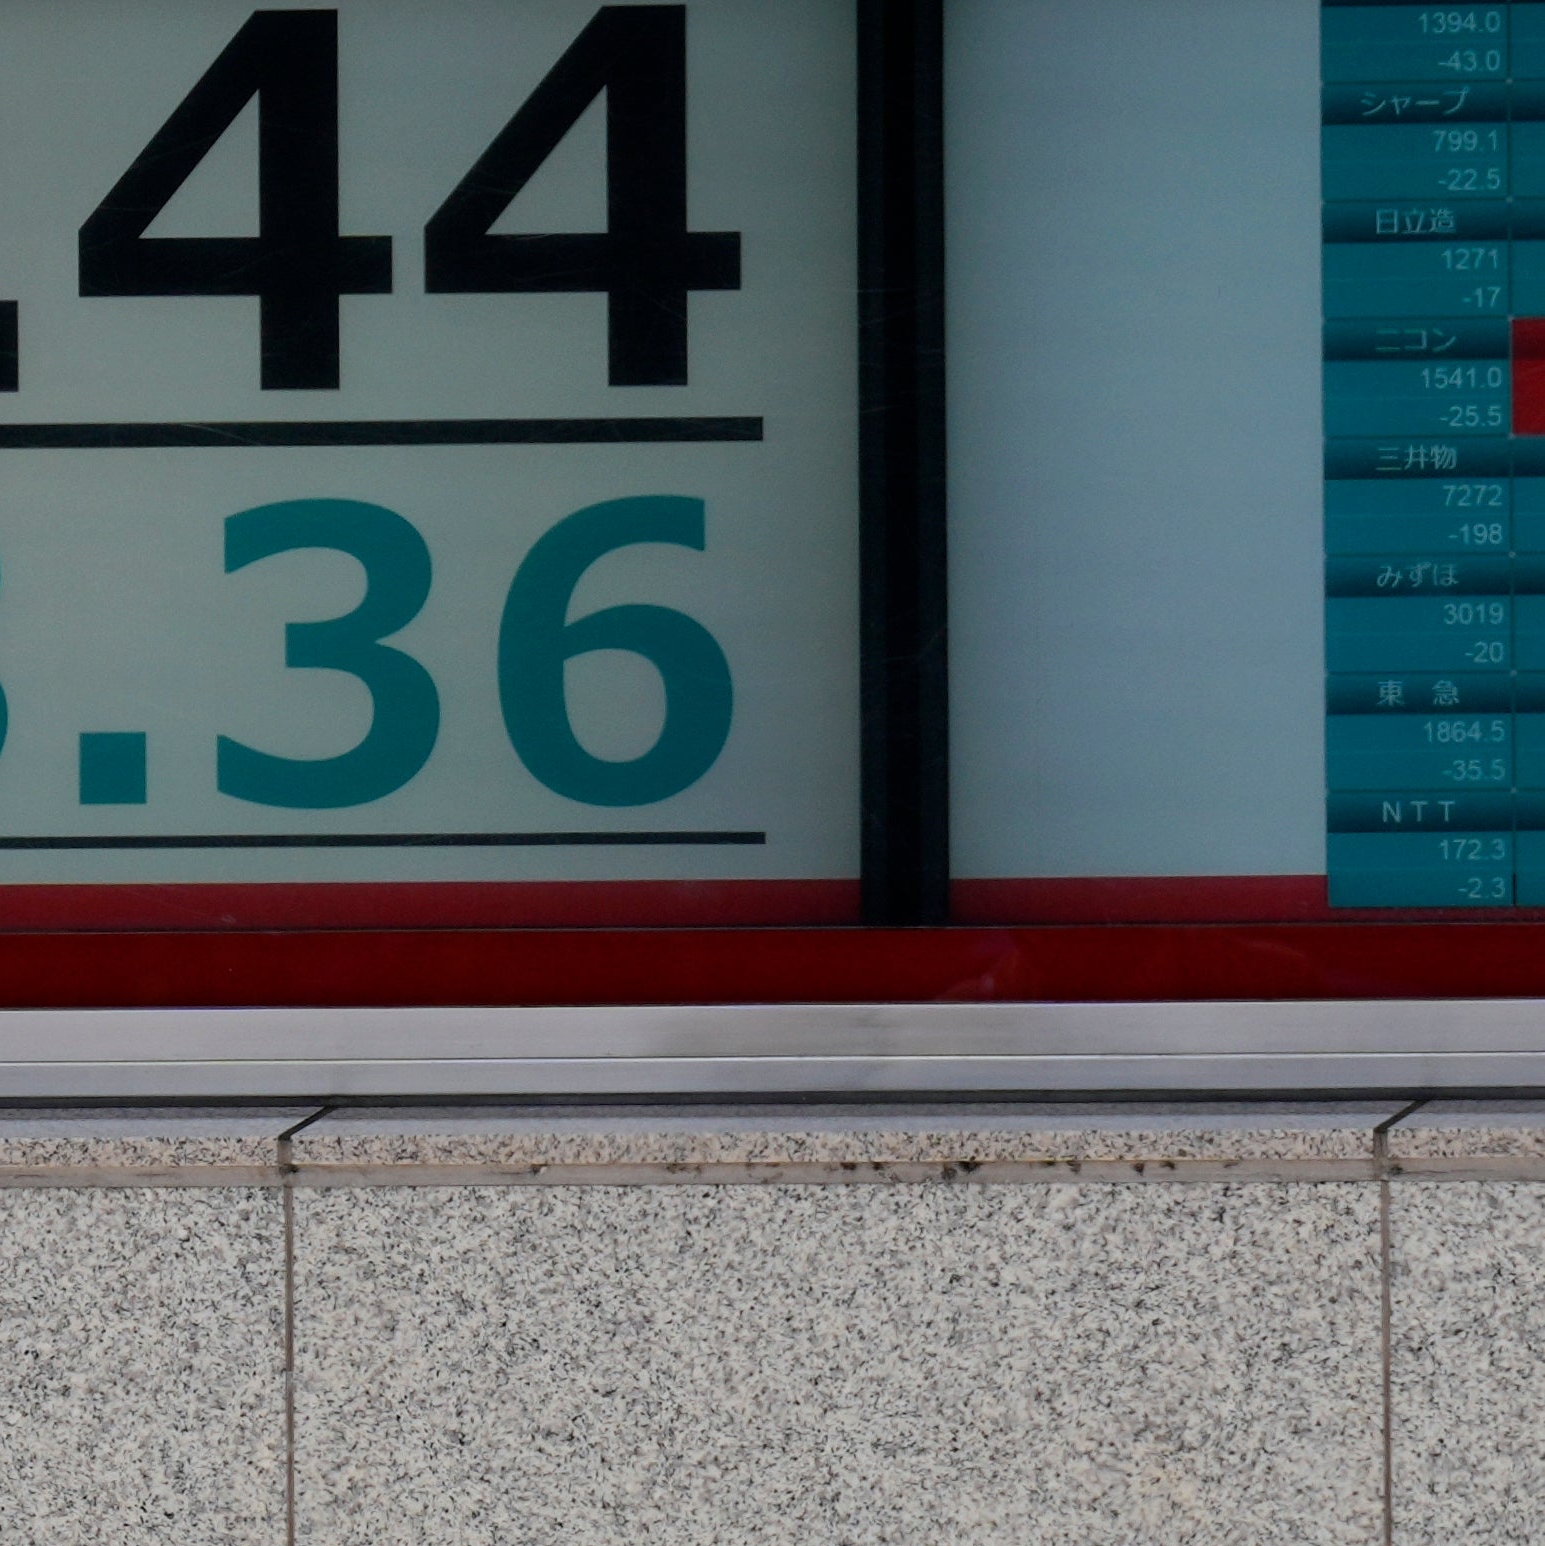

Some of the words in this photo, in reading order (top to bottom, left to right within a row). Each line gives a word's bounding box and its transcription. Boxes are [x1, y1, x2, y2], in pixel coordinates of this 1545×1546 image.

[1418, 12, 1500, 32] 1394.0
[1439, 50, 1500, 71] -43.0
[1362, 87, 1469, 116] シャープ
[1433, 130, 1499, 152] 799.1
[1438, 169, 1500, 190] -22.5
[1376, 208, 1456, 235] 日立造
[1441, 248, 1499, 269] 1271
[1463, 287, 1500, 307] -17
[1375, 329, 1456, 353] ニコン
[1421, 368, 1501, 388] 1541.0
[1439, 406, 1502, 427] -25.5
[1375, 444, 1458, 471] 三井物
[1442, 484, 1503, 506] 7272
[1447, 523, 1503, 545] -198
[1377, 561, 1459, 589] みずほ
[1443, 603, 1504, 625] 3019
[1464, 642, 1505, 664] -20
[1423, 720, 1505, 743] 1864.5
[1442, 759, 1506, 782] -35.5
[1382, 800, 1456, 823] NTT
[1439, 839, 1505, 861] 172.3
[1457, 877, 1505, 899] -2.3
